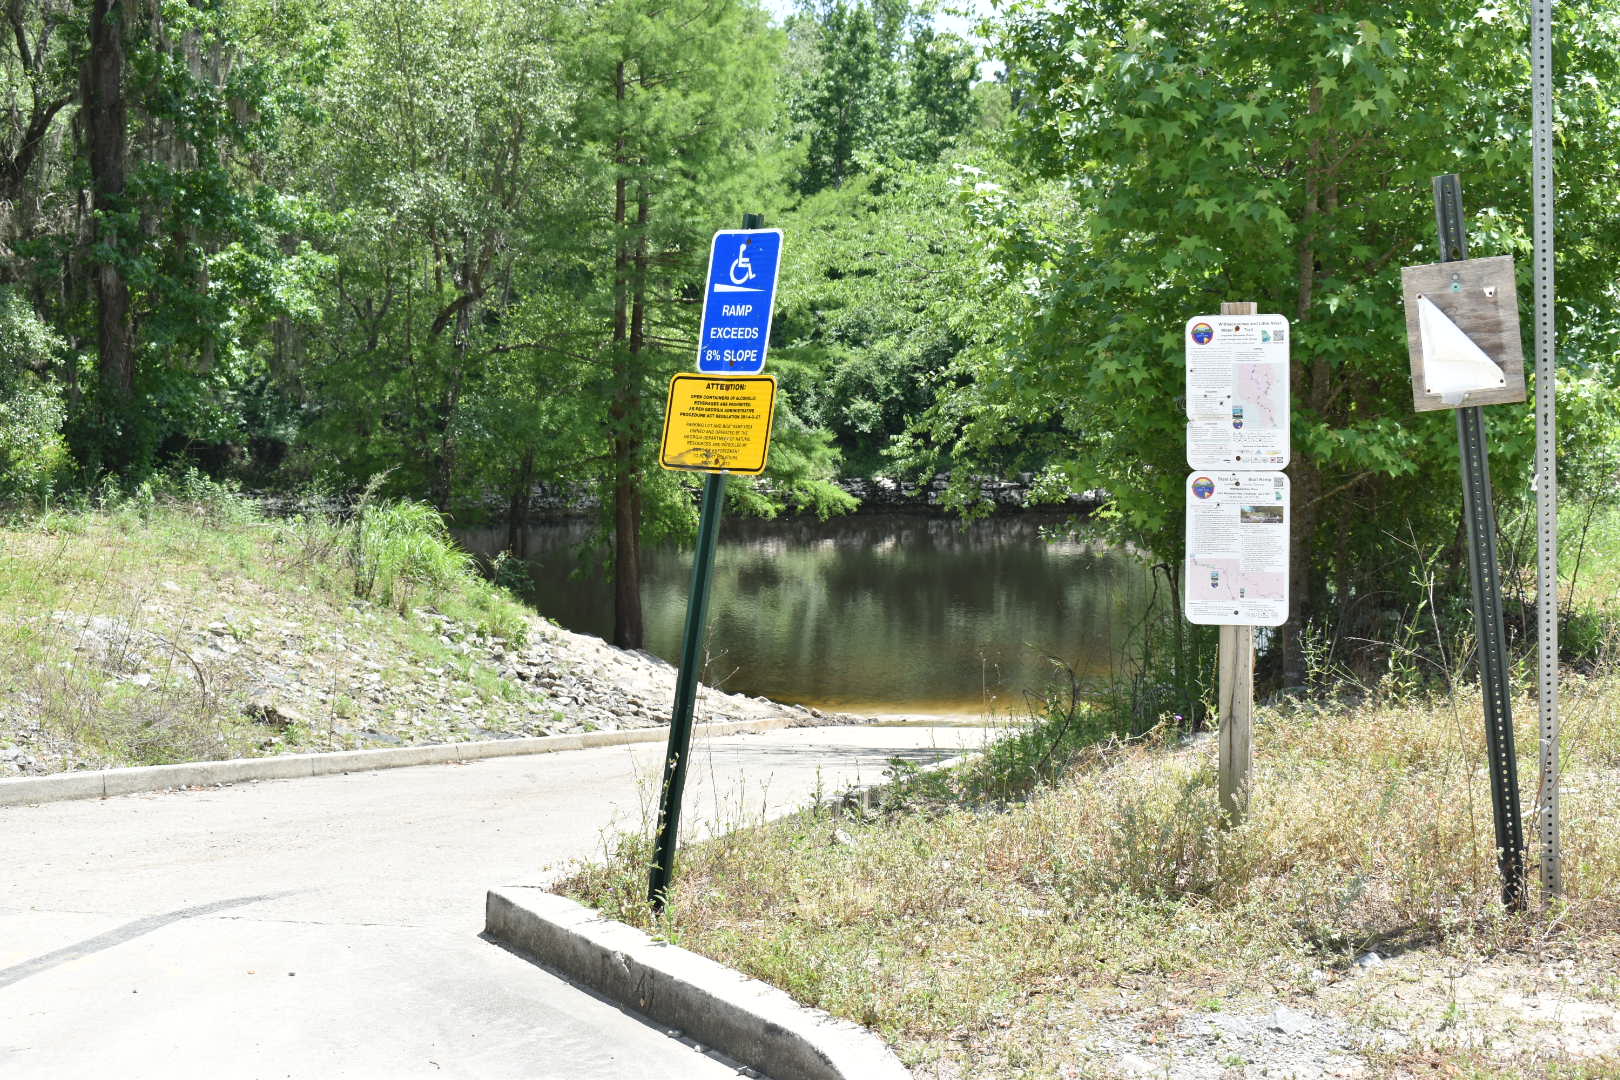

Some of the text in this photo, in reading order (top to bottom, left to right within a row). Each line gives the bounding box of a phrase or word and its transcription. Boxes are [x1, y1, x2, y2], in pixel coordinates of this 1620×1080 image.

[722, 304, 752, 316] RAMP
[710, 328, 759, 339] EXCEEDS
[706, 350, 758, 362] 8% SLOPE
